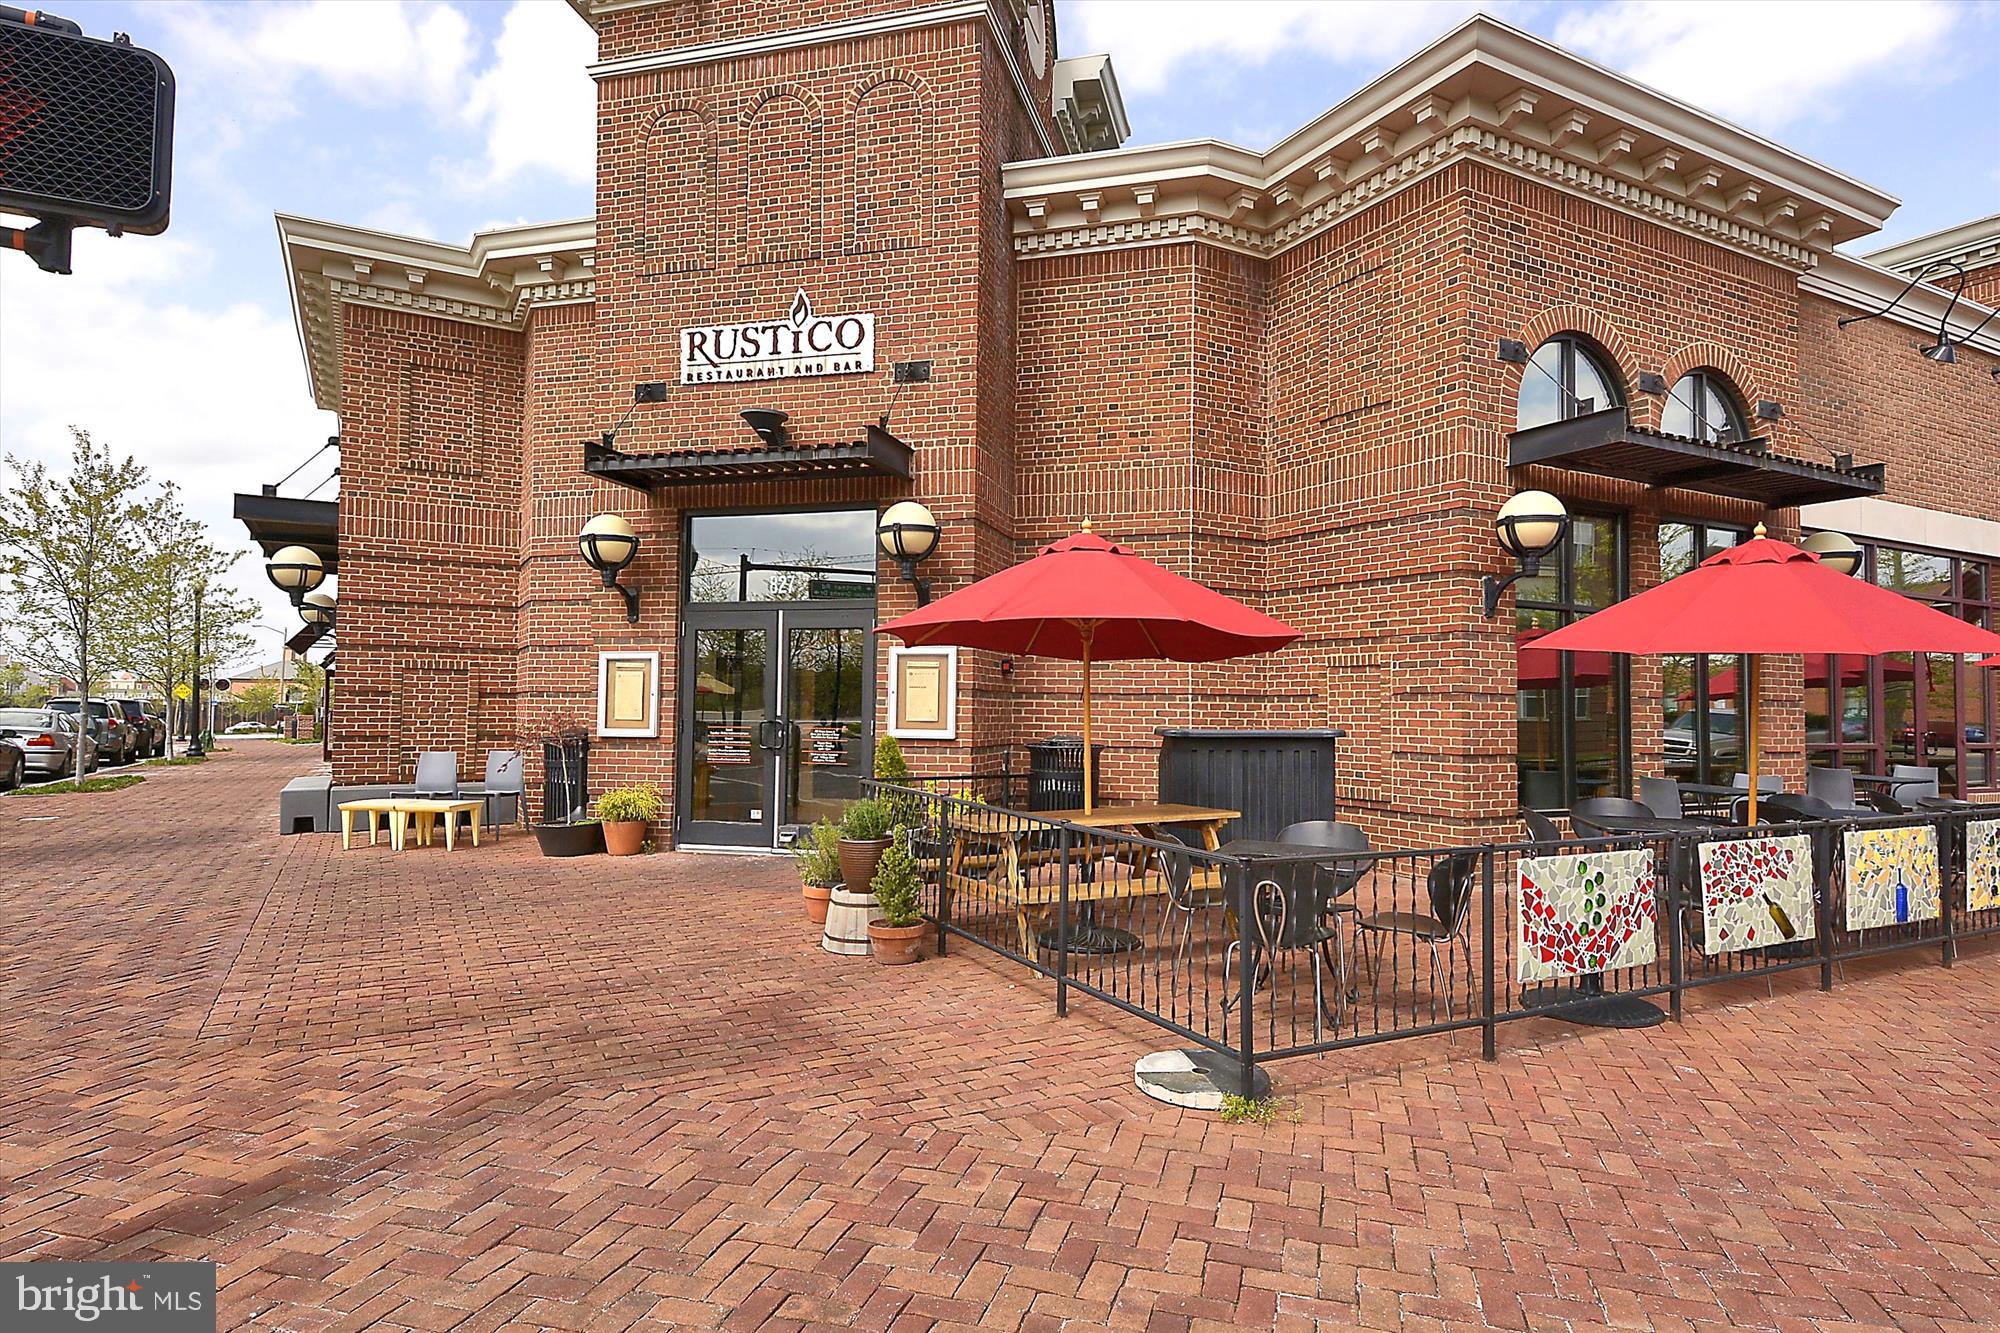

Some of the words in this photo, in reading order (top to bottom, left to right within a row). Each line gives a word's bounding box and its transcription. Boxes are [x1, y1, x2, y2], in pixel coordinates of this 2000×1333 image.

[686, 317, 866, 368] RUSTICO
[686, 366, 785, 382] RESTAURANT
[793, 362, 824, 374] AND
[833, 360, 863, 372] BAR
[770, 575, 795, 594] 827
